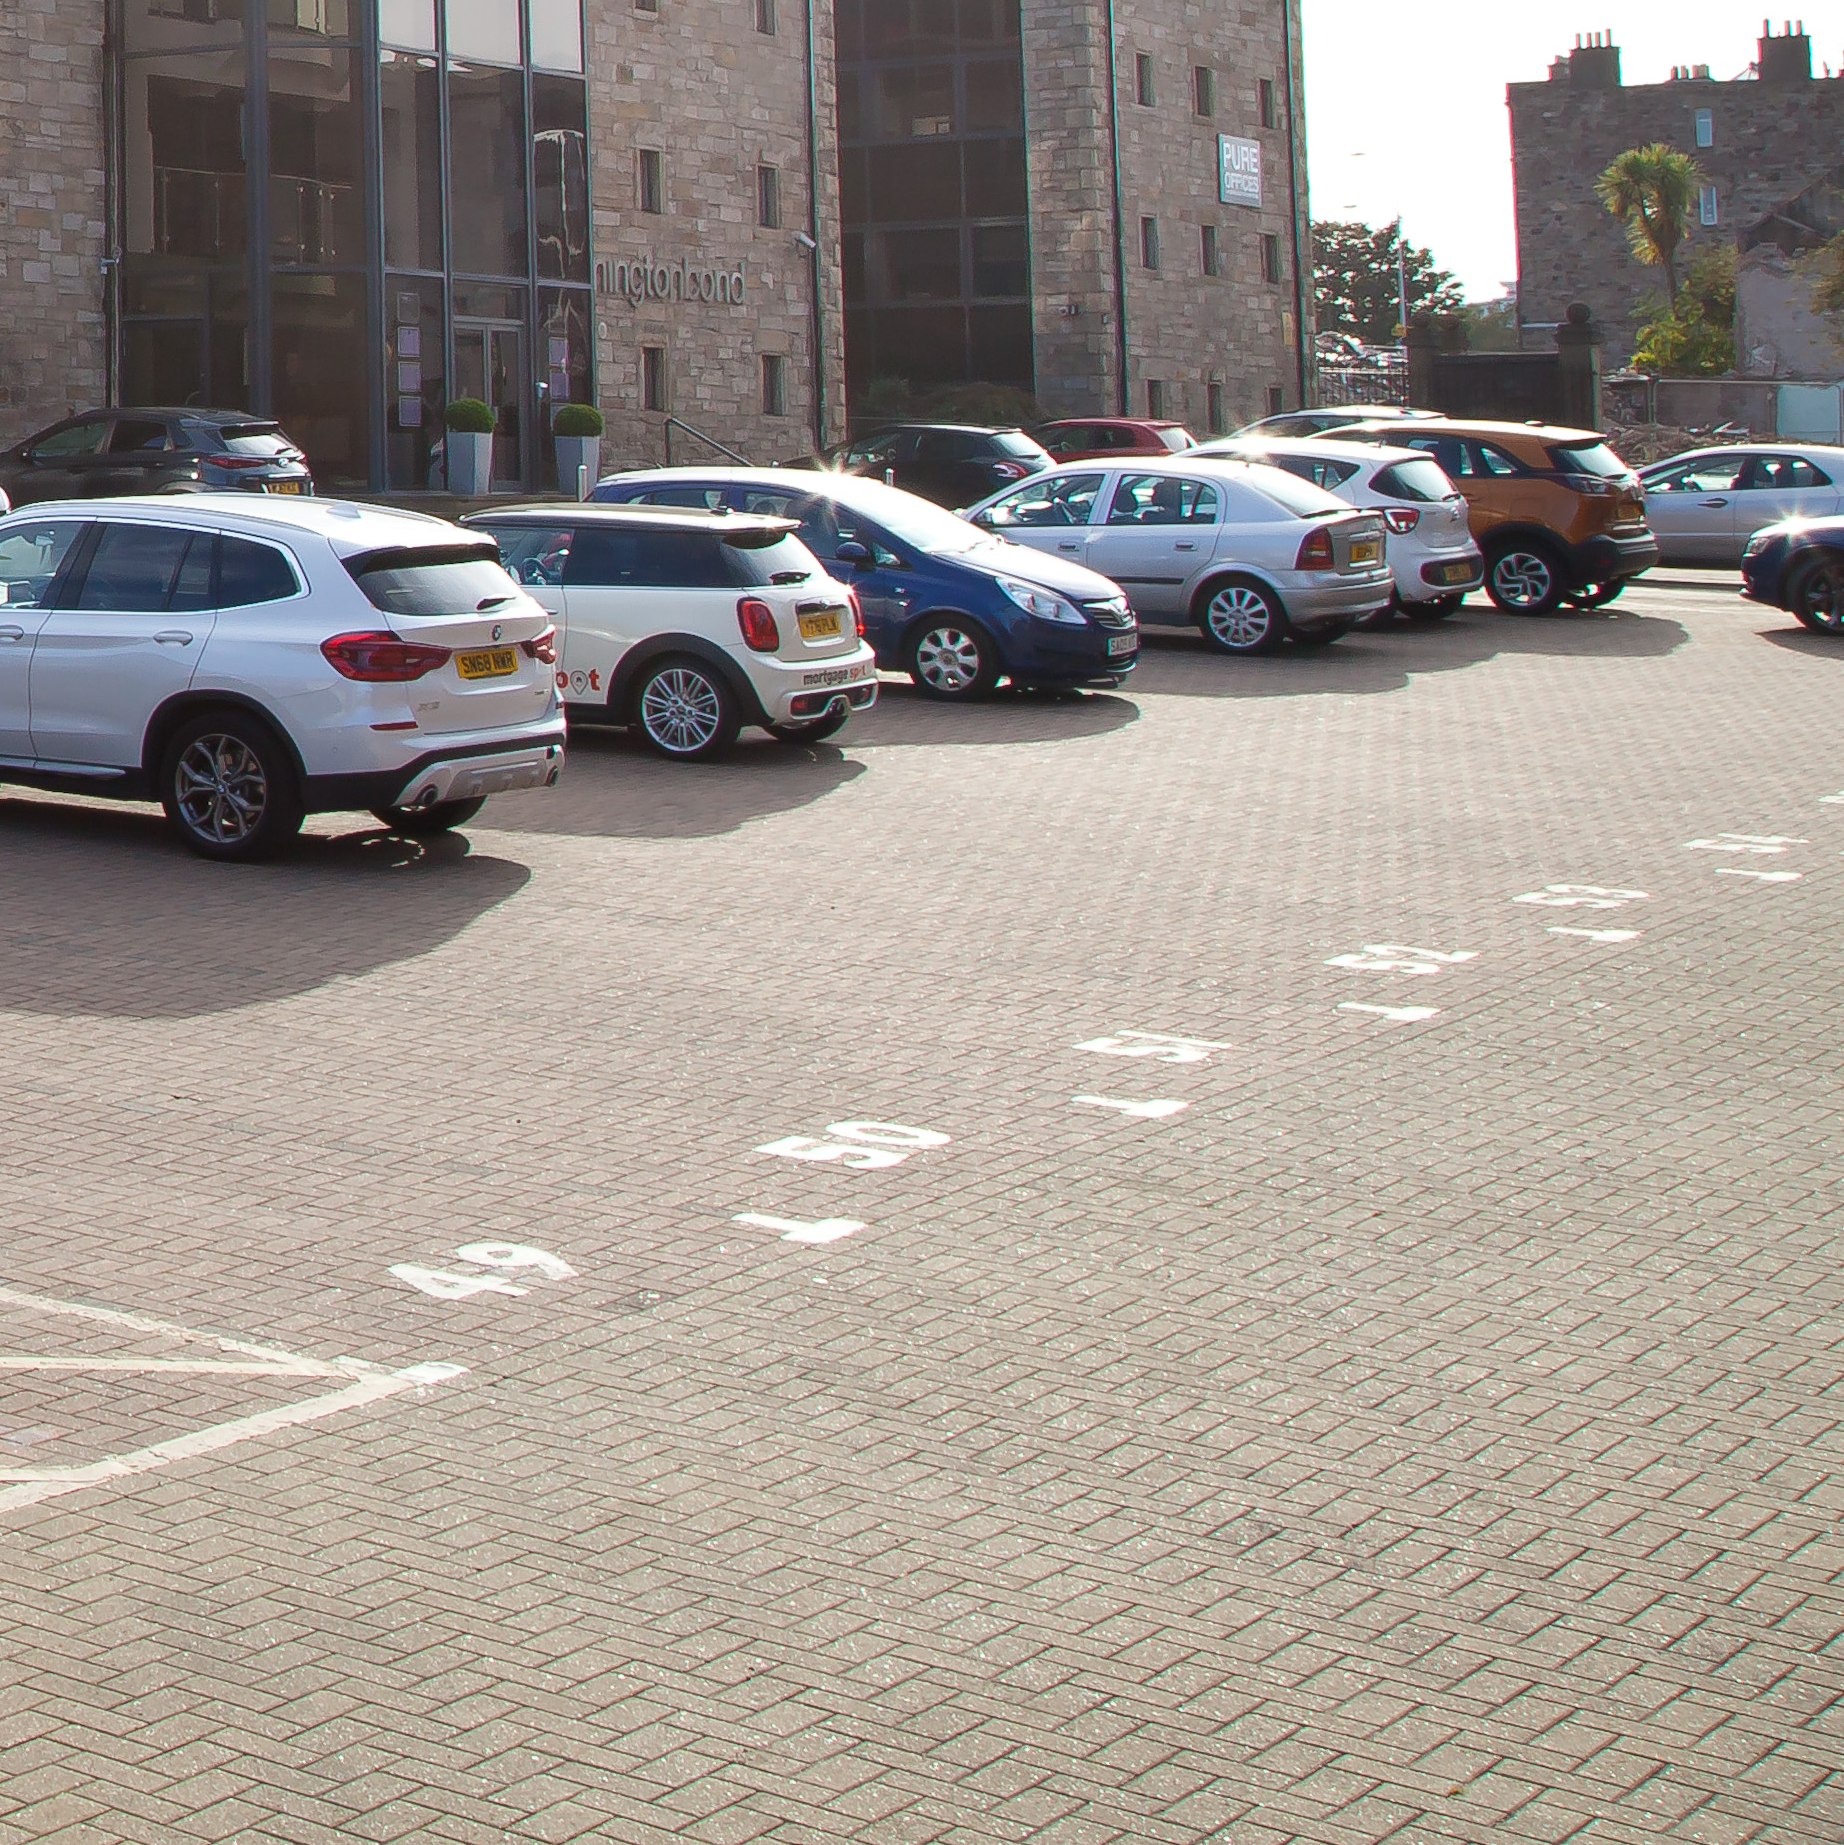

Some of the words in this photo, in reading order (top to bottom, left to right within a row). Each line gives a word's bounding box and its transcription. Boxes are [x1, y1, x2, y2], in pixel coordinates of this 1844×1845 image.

[1222, 142, 1259, 173] PURE
[1223, 171, 1259, 193] OFFICES
[803, 668, 848, 686] mortgage
[1322, 943, 1481, 975] 52
[1071, 1029, 1233, 1063] 51
[752, 1120, 952, 1170] 50
[386, 1241, 580, 1301] 49
